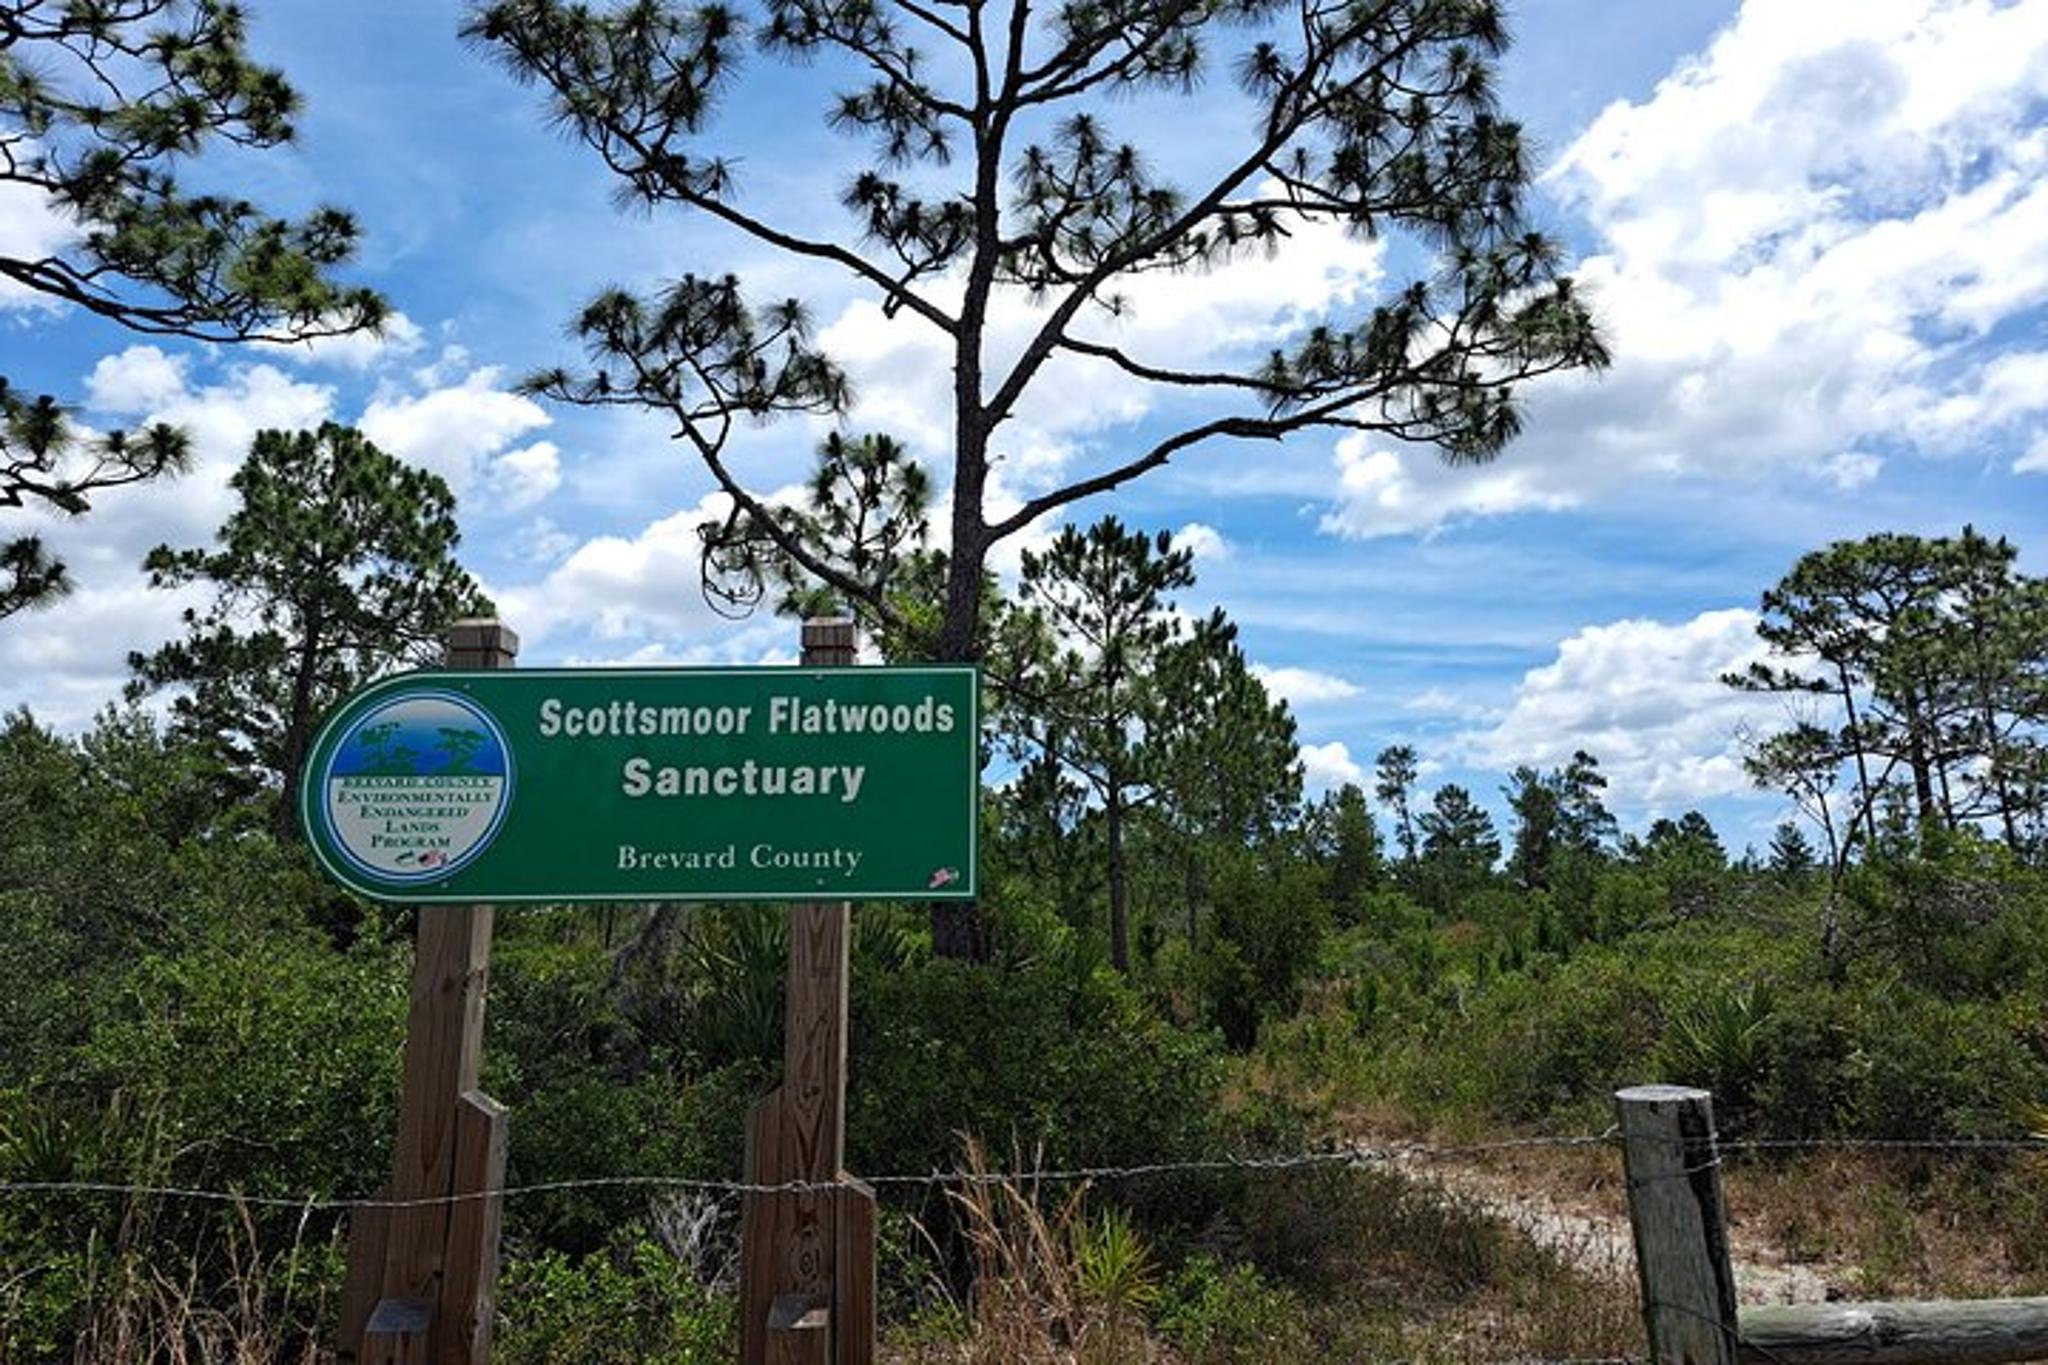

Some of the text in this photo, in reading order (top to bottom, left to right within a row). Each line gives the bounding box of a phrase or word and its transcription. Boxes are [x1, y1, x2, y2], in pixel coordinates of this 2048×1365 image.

[539, 696, 955, 737] Scottsmoor Flatwoods
[622, 757, 865, 802] Sanctuary
[338, 790, 493, 803] ENVIRONMENTALLY
[360, 805, 470, 818] ENDANGERED
[385, 821, 440, 833] LANDS
[371, 835, 451, 848] PROGRAM
[617, 843, 863, 875] Brevard County
